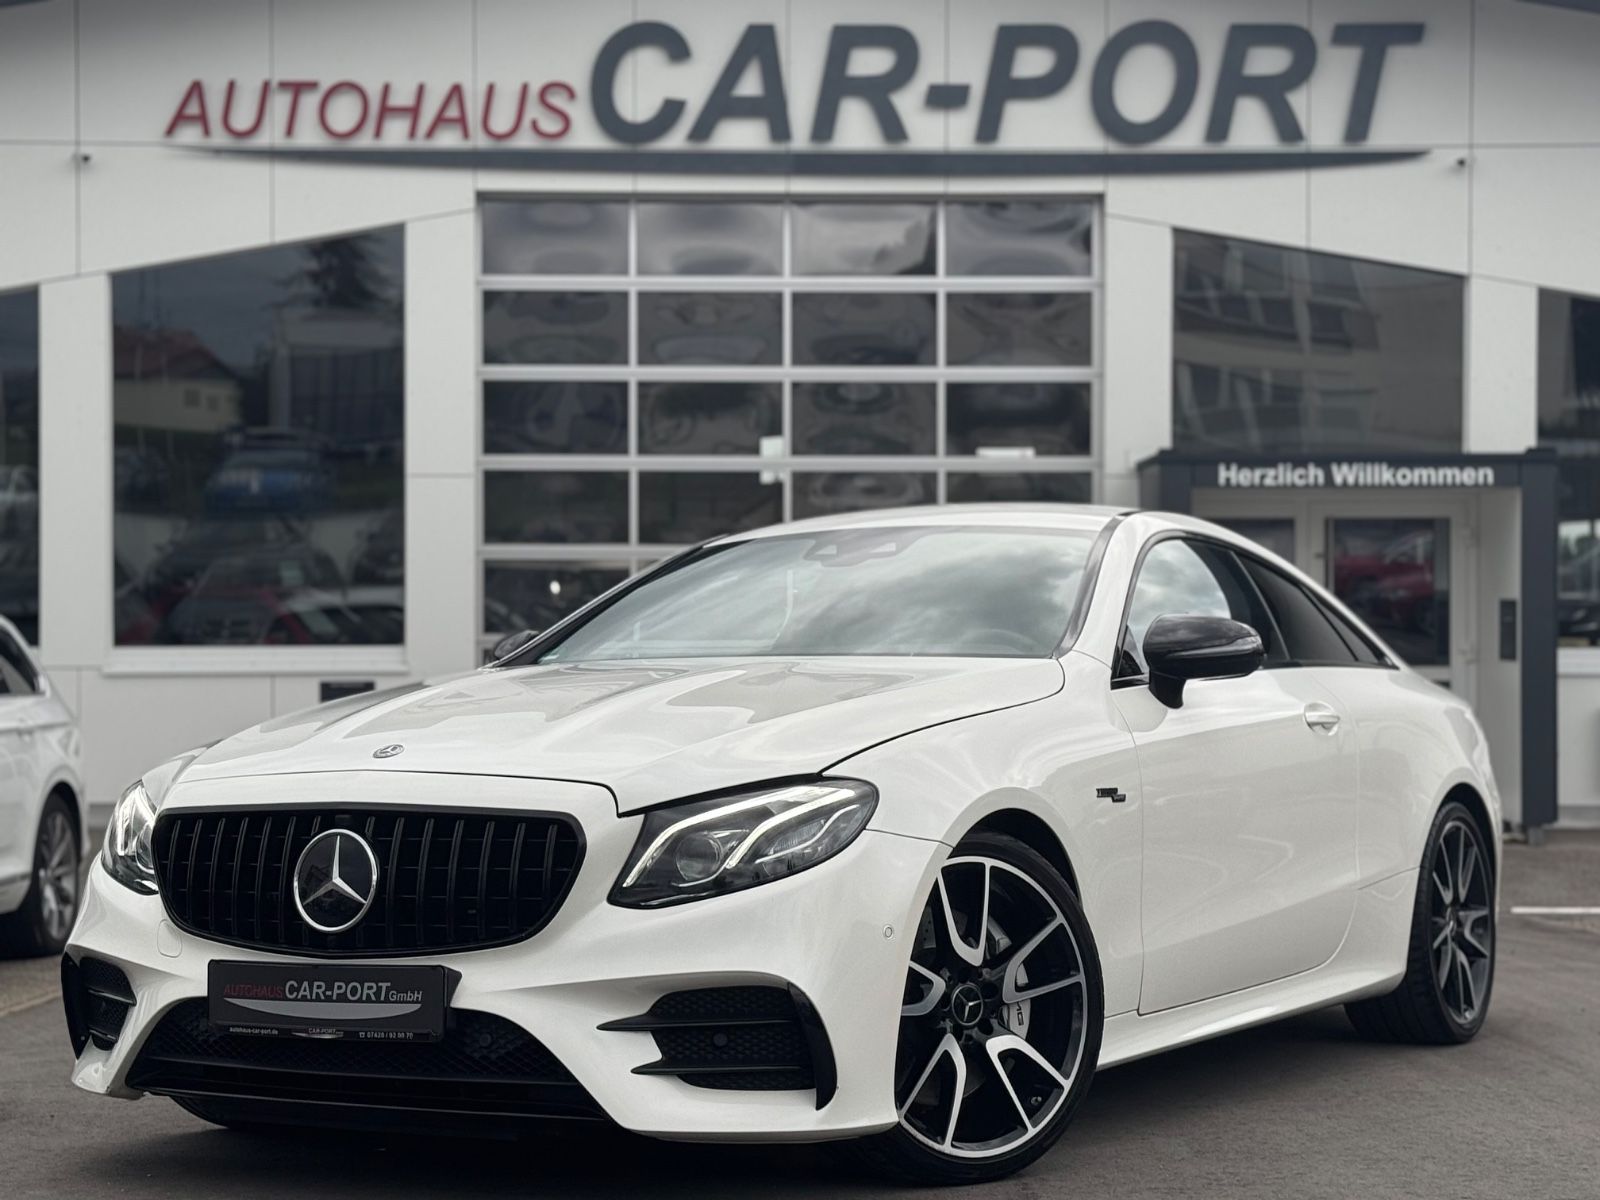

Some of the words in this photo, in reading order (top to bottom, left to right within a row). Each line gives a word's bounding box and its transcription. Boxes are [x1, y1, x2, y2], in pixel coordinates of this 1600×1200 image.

[164, 79, 577, 142] AUTOHAUS
[590, 18, 1426, 146] CAR-PORT
[1217, 462, 1325, 487] Herzlich
[1331, 462, 1494, 487] Willkommen
[223, 984, 284, 998] AUTOHAUS
[285, 980, 391, 1001] CAR-PORT
[388, 989, 423, 1003] GmbH
